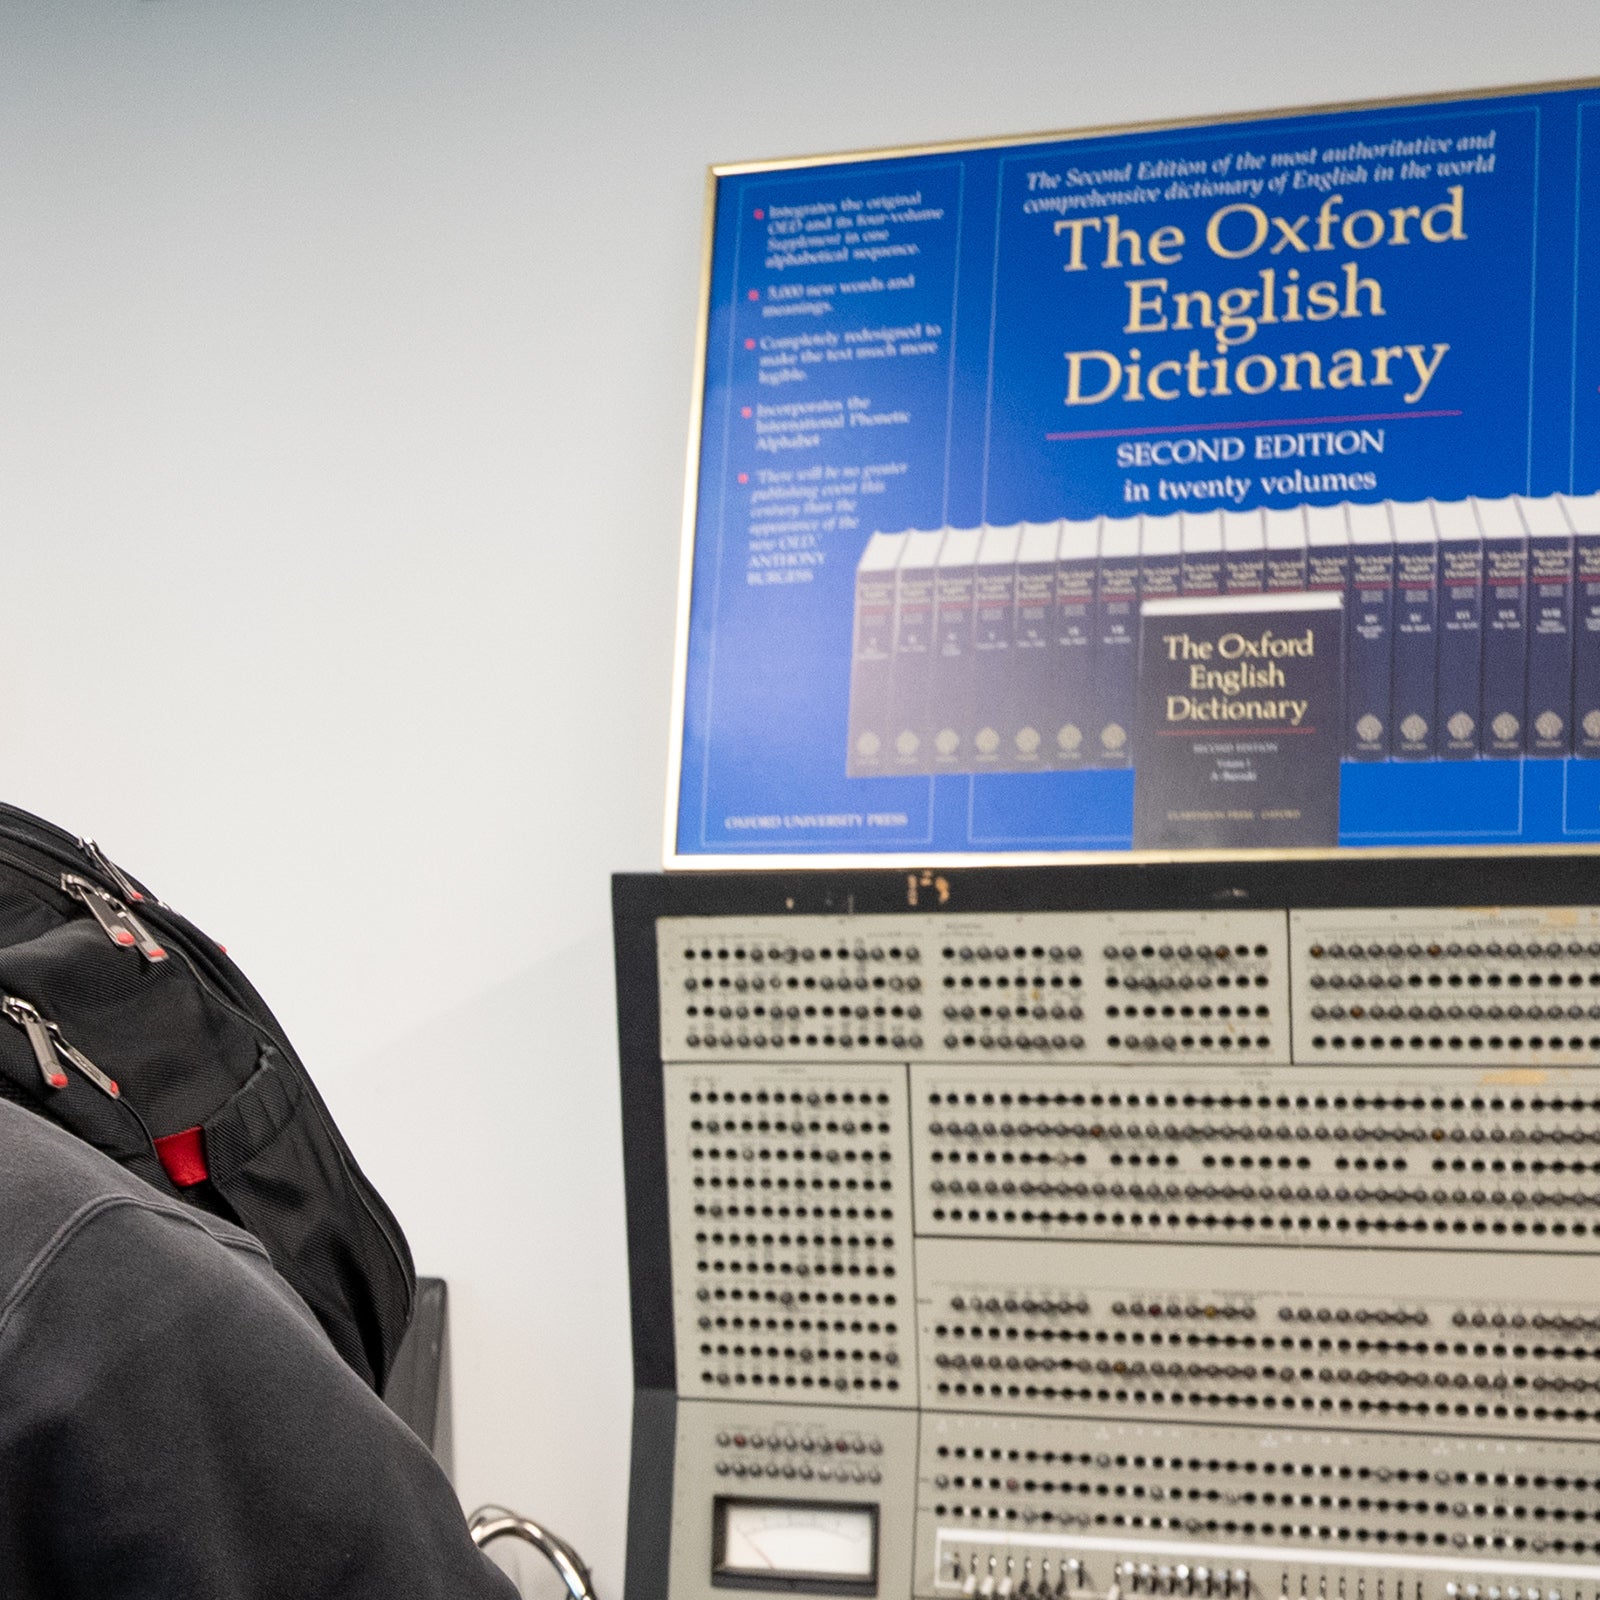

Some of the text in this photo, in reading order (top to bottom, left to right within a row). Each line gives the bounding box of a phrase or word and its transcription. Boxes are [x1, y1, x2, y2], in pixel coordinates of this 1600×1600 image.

[1022, 153, 1496, 216] comprehensive dictionary of English in the world
[1026, 129, 1496, 192] The Second Edition of the most authoritative and
[1054, 185, 1468, 272] The Oxford
[1123, 262, 1386, 346] English
[1063, 342, 1451, 406] Dictionary
[1116, 429, 1386, 467] SECOND EDITION
[1123, 469, 1377, 503] in twenty volumes
[1163, 629, 1314, 660] The Oxford
[1190, 660, 1286, 696] English
[1166, 695, 1308, 726] Dictionary
